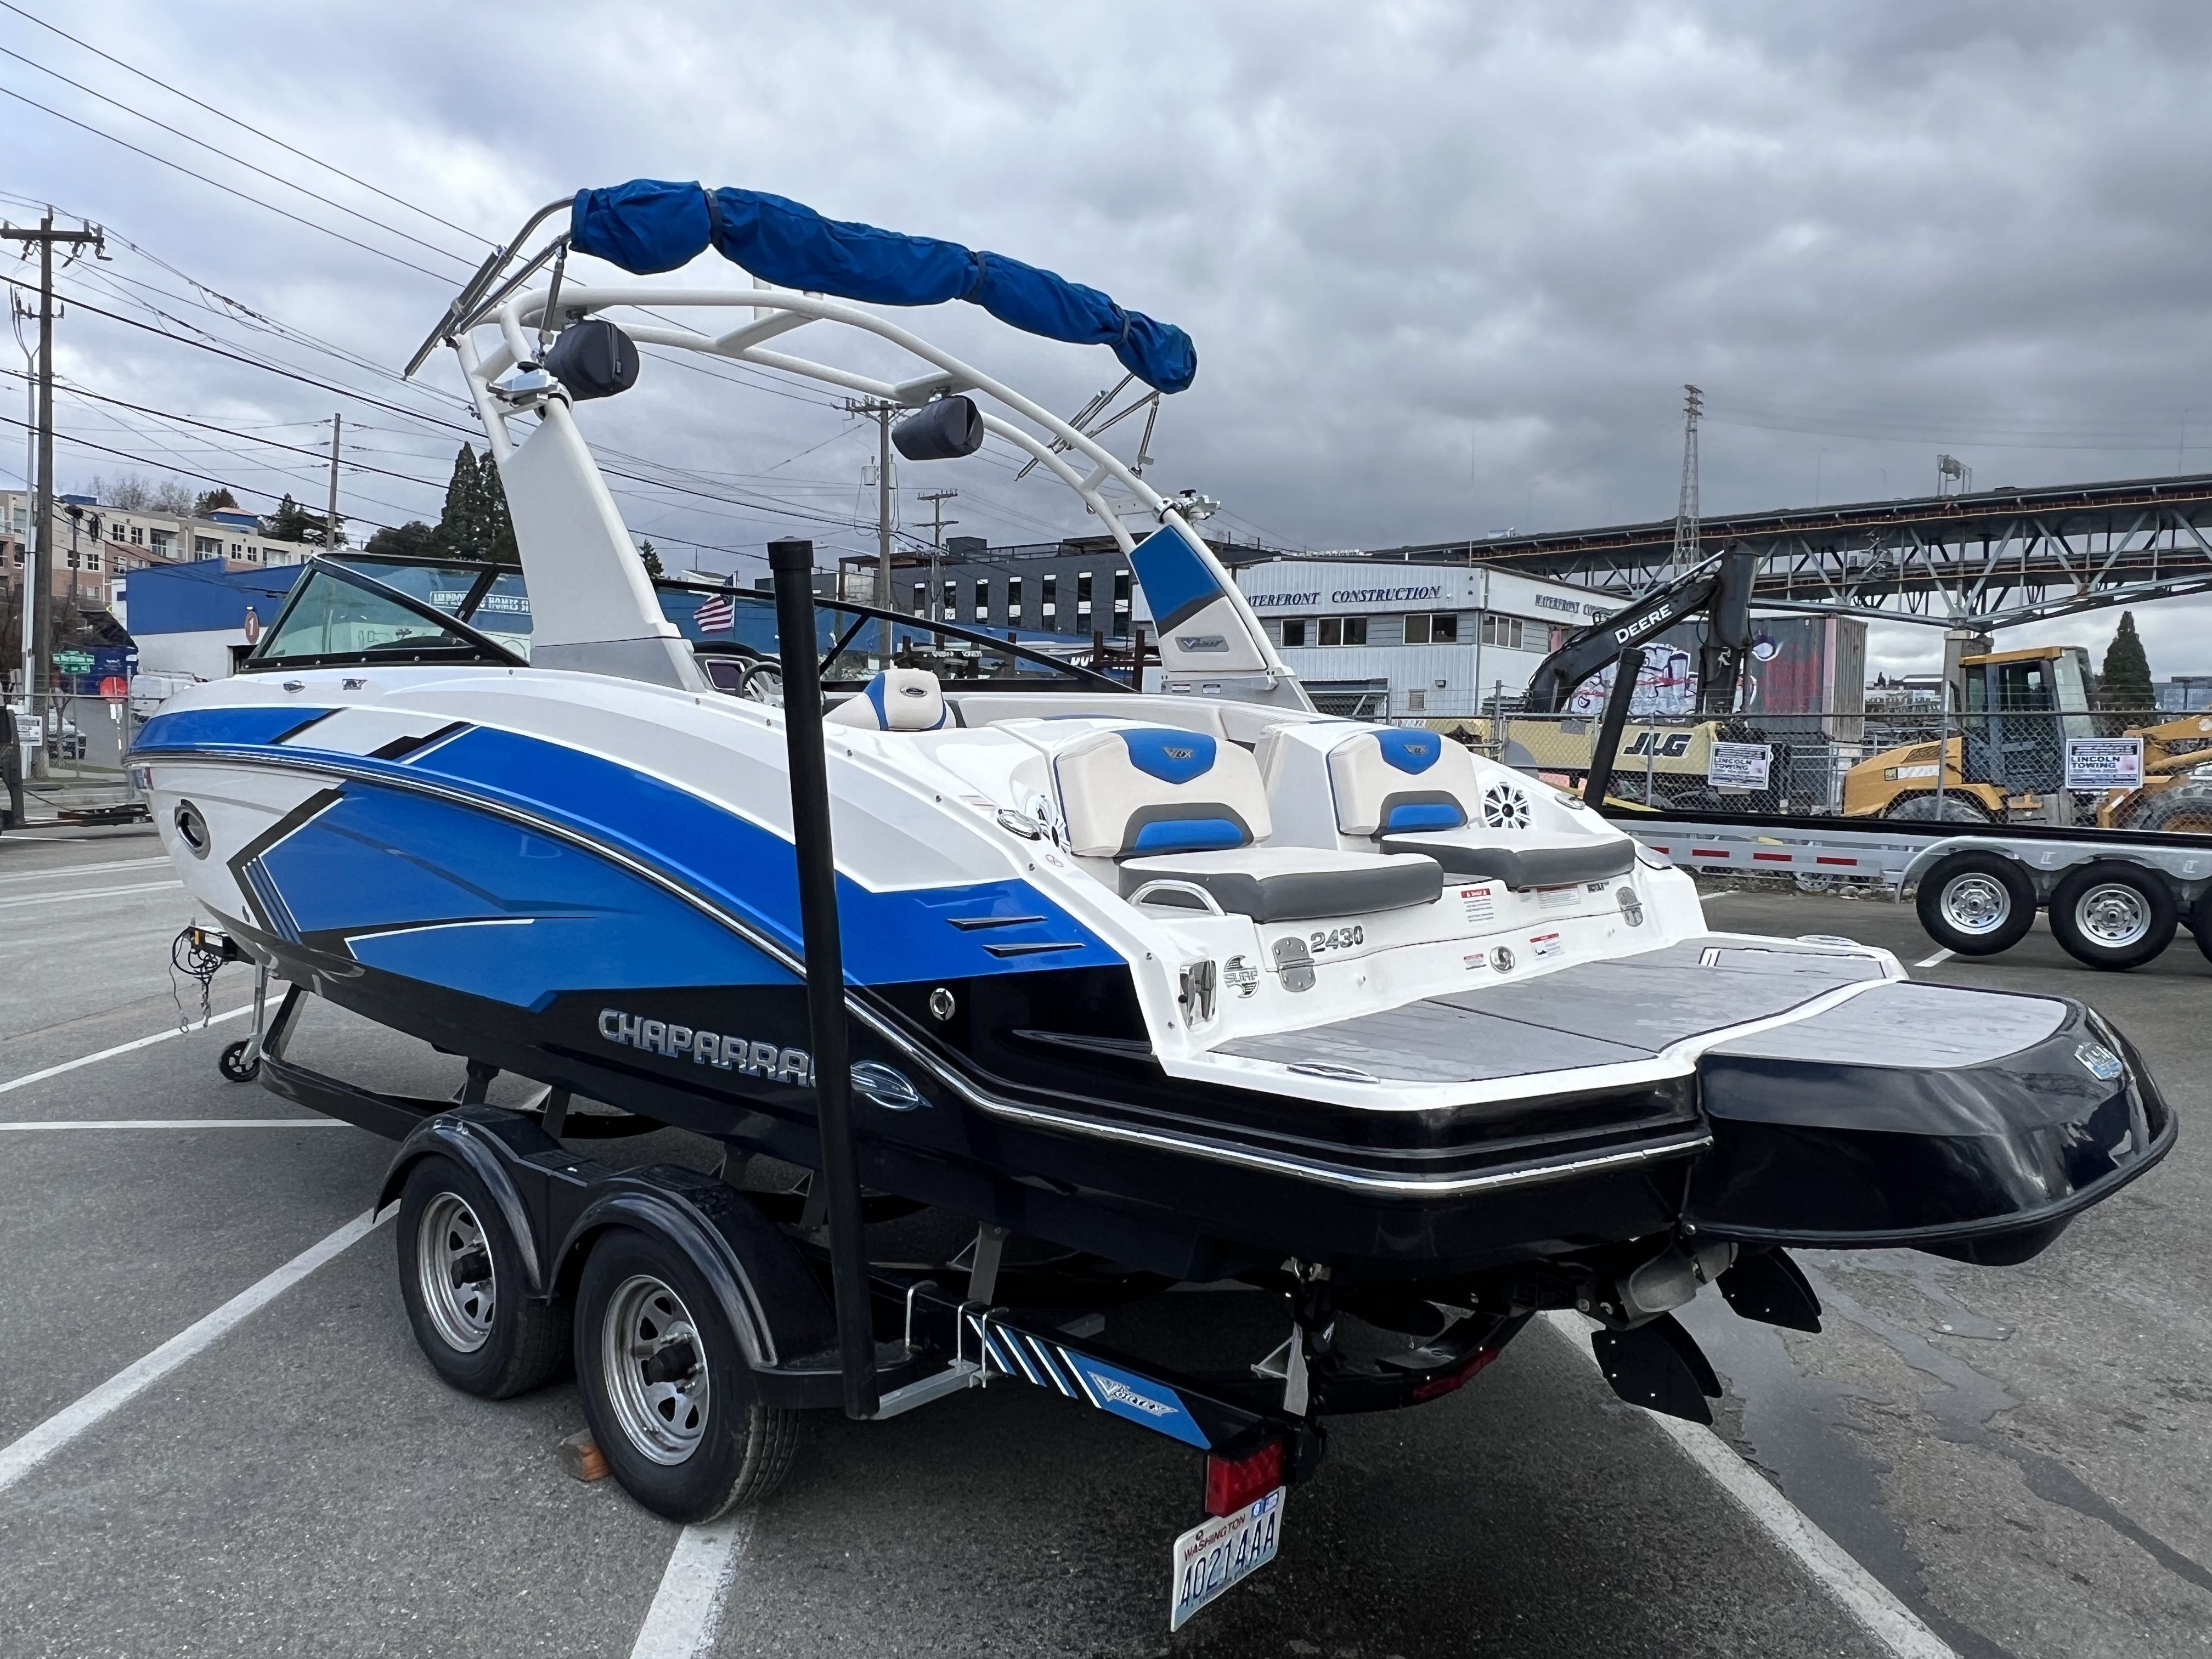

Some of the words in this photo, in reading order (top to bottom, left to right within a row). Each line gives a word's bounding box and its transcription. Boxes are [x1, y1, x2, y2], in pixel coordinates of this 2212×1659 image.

[1332, 585, 1442, 603] CONSTRUCTION
[249, 617, 255, 636] 1
[1615, 603, 1673, 644] DEERE
[1621, 732, 1694, 758] JLG
[1310, 925, 1363, 953] 2430
[598, 1008, 816, 1087] CHAPARRA
[1184, 1513, 1246, 1562] WASHINGTON
